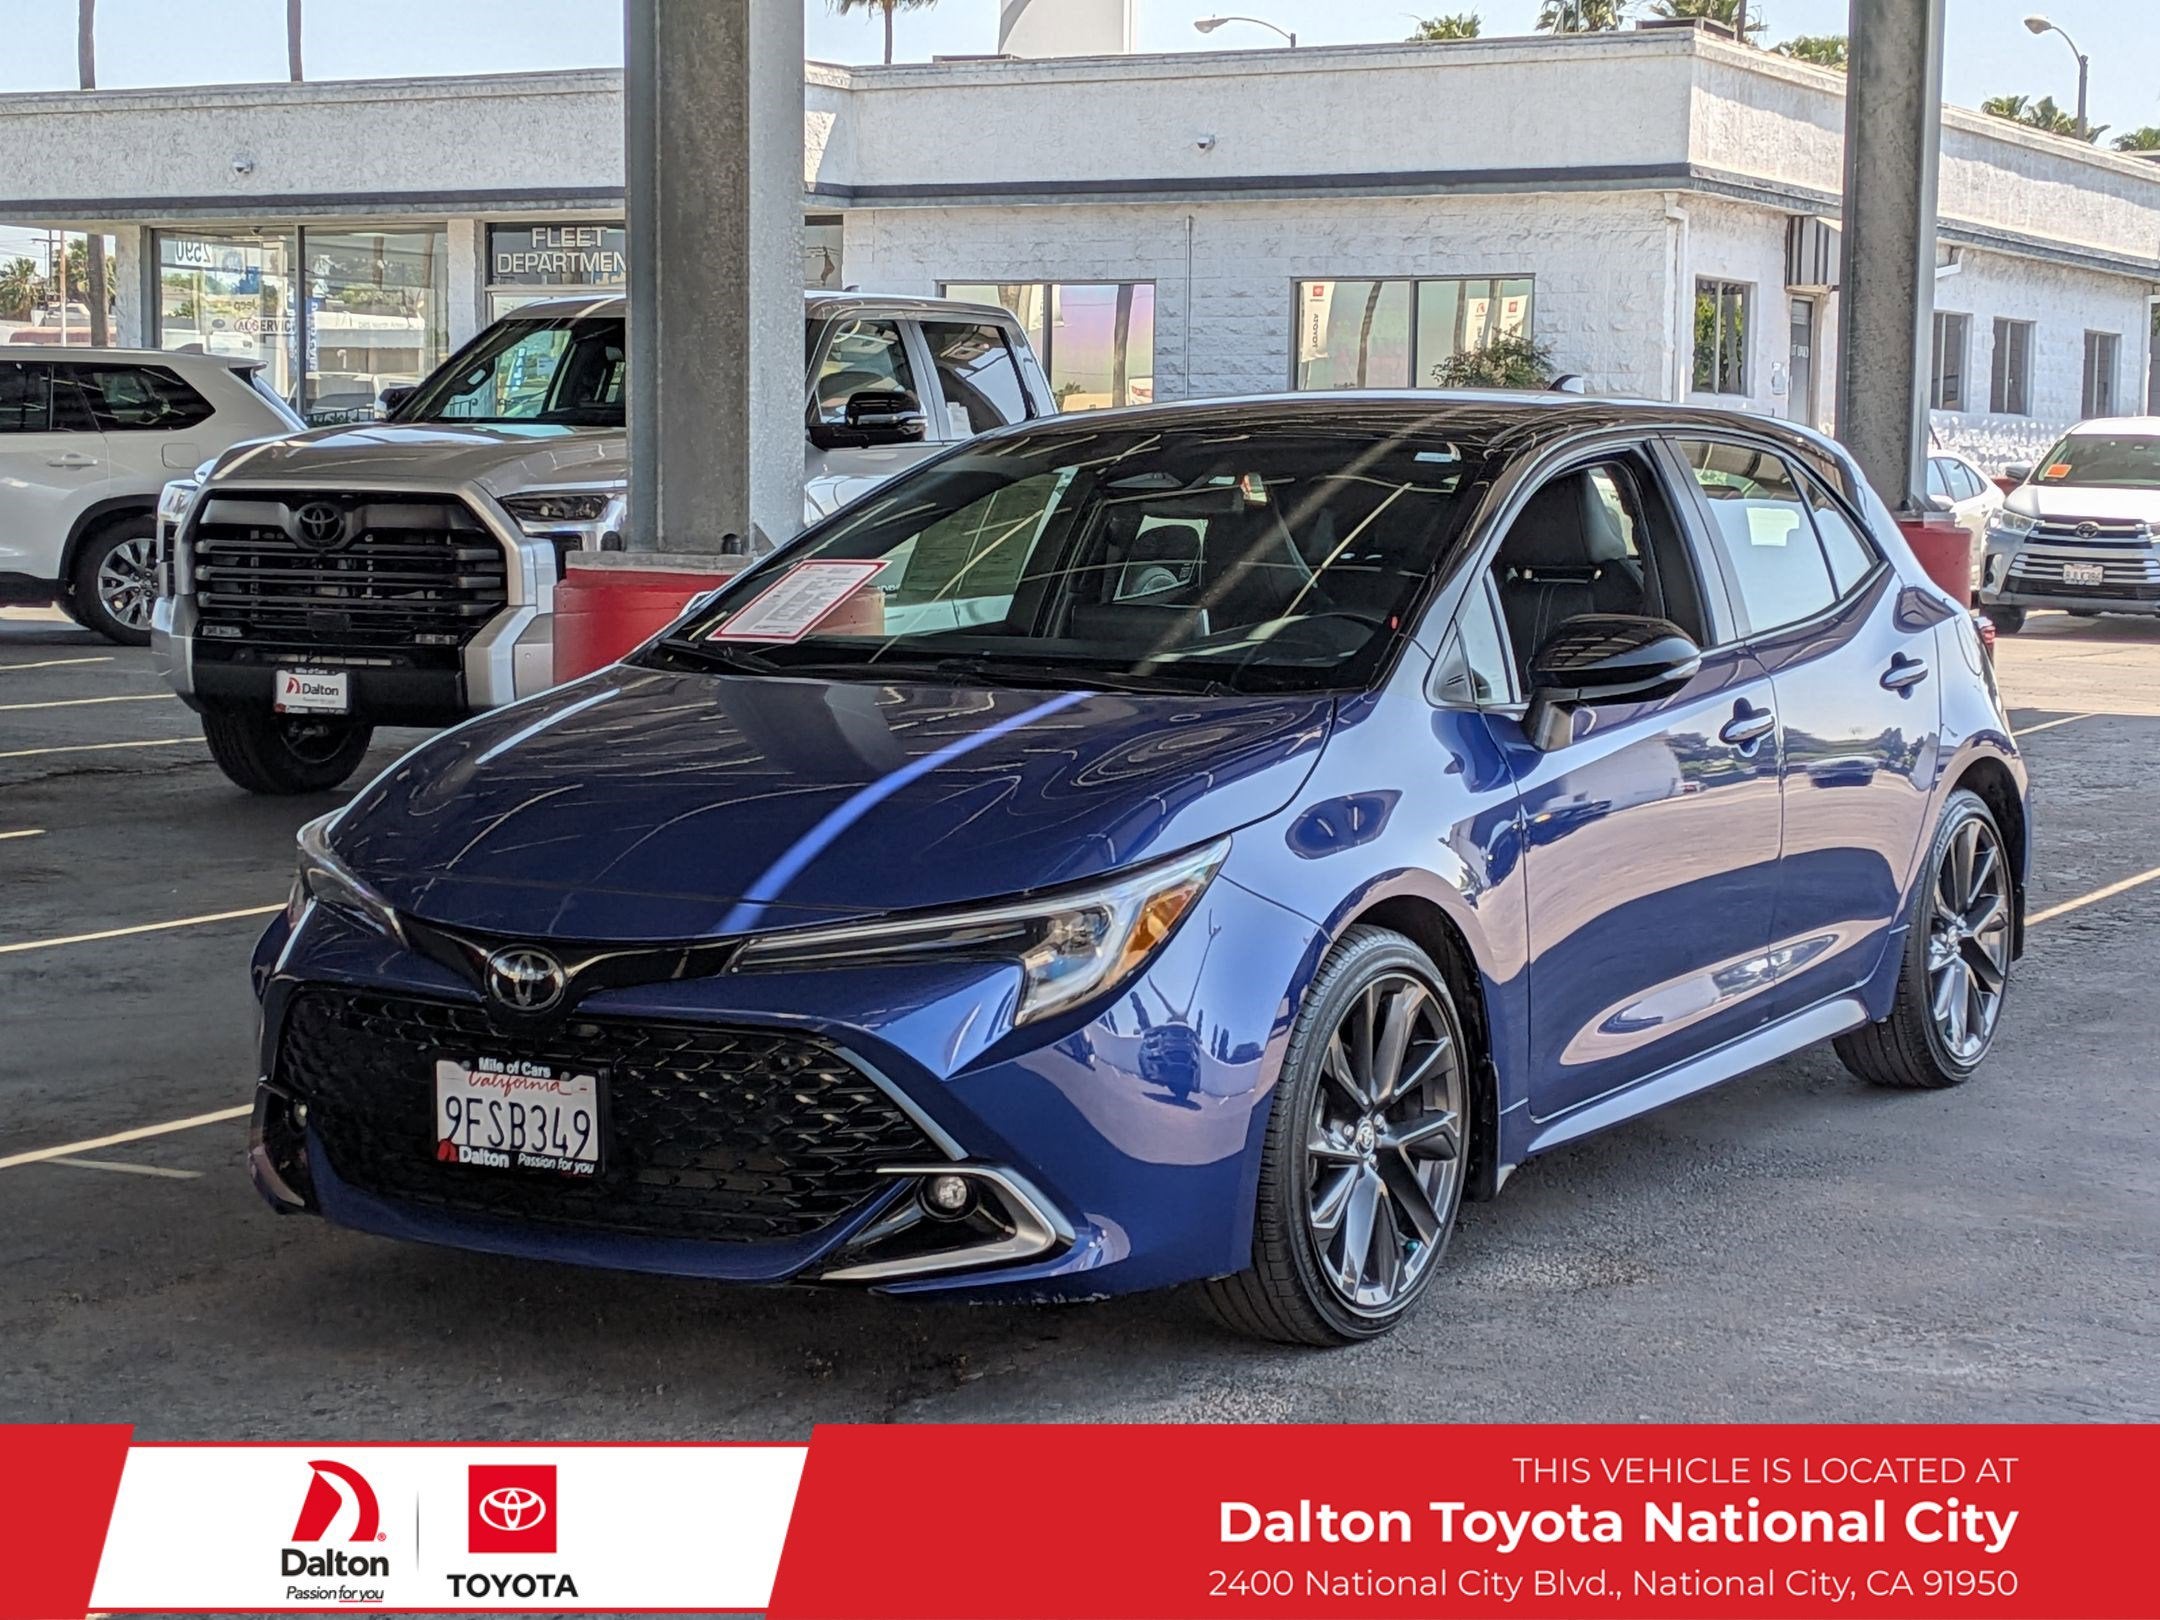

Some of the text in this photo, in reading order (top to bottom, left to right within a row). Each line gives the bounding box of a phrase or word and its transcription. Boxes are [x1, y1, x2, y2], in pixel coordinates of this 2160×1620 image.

[531, 226, 608, 249] FLEET
[497, 251, 626, 274] DEPARTMEN
[302, 683, 339, 696] Dalton
[478, 1057, 551, 1078] Mile of Cars
[468, 1071, 572, 1098] California
[445, 1095, 591, 1159] 9FSB349
[459, 1146, 595, 1175] Dalton Passion for you
